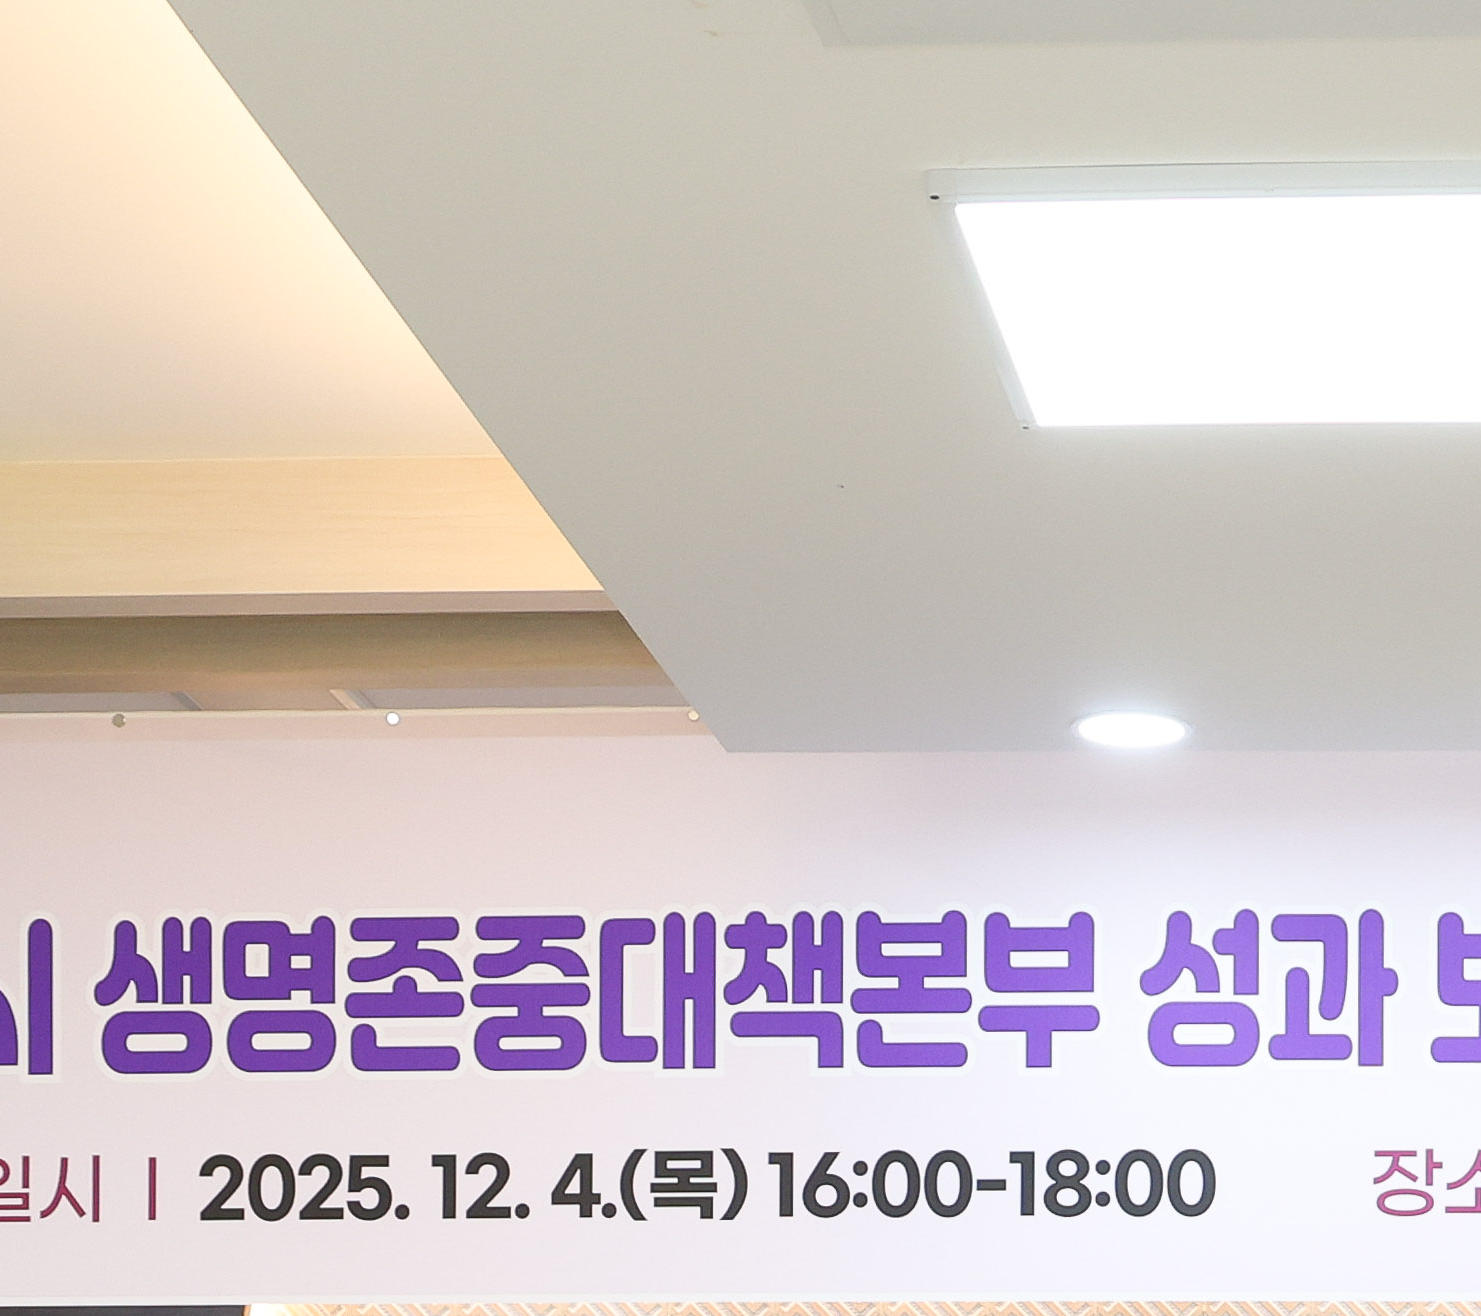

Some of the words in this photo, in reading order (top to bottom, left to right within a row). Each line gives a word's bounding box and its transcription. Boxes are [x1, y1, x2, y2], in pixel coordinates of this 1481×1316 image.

[91, 908, 1101, 1076] 생명존중대책본부
[1138, 907, 1399, 1069] 성과
[198, 1154, 410, 1223] 2025.
[430, 1154, 530, 1221] 12.
[548, 1148, 750, 1226] 4.(목)
[768, 1147, 1218, 1221] 16:00-18:00
